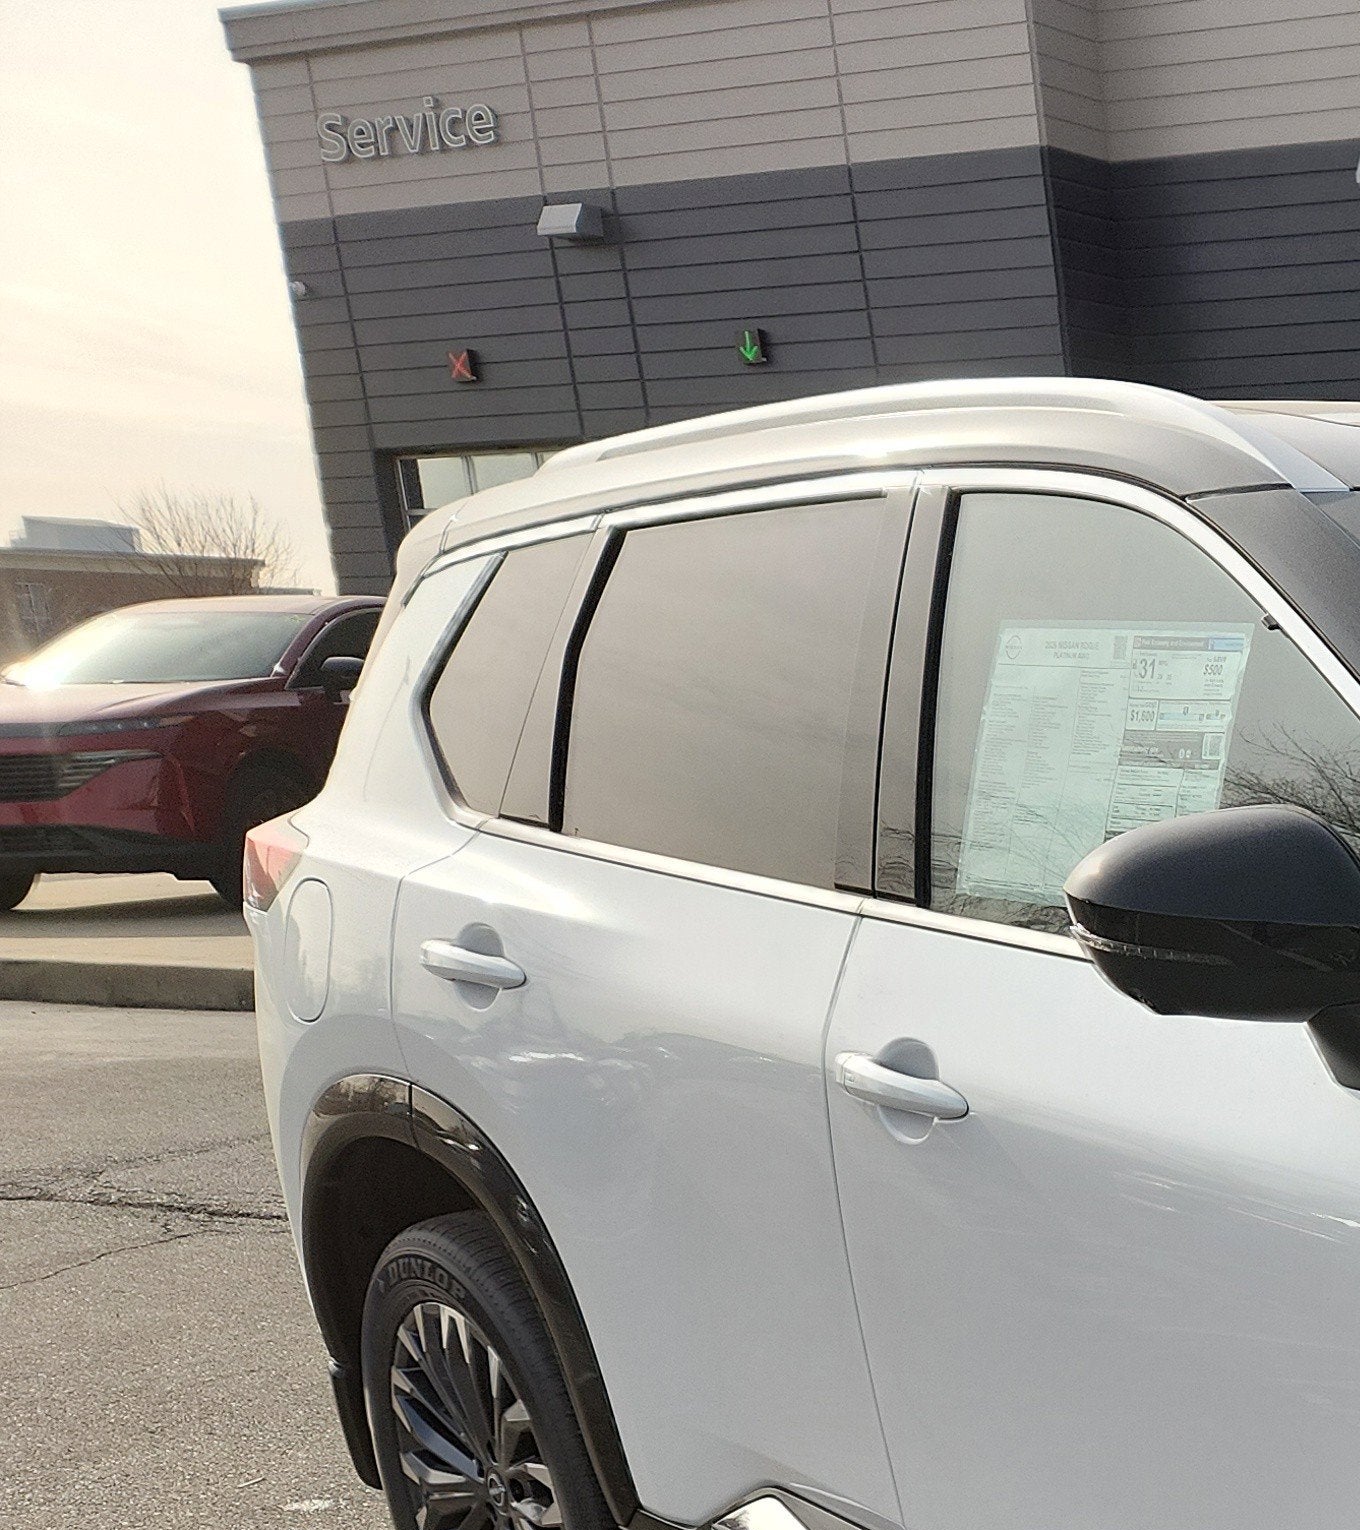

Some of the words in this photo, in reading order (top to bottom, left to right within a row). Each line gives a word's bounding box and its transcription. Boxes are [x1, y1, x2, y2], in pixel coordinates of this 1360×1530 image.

[316, 96, 495, 162] Service
[1139, 658, 1156, 679] 31
[1203, 663, 1224, 675] $500
[387, 1258, 466, 1300] DUNLOP
